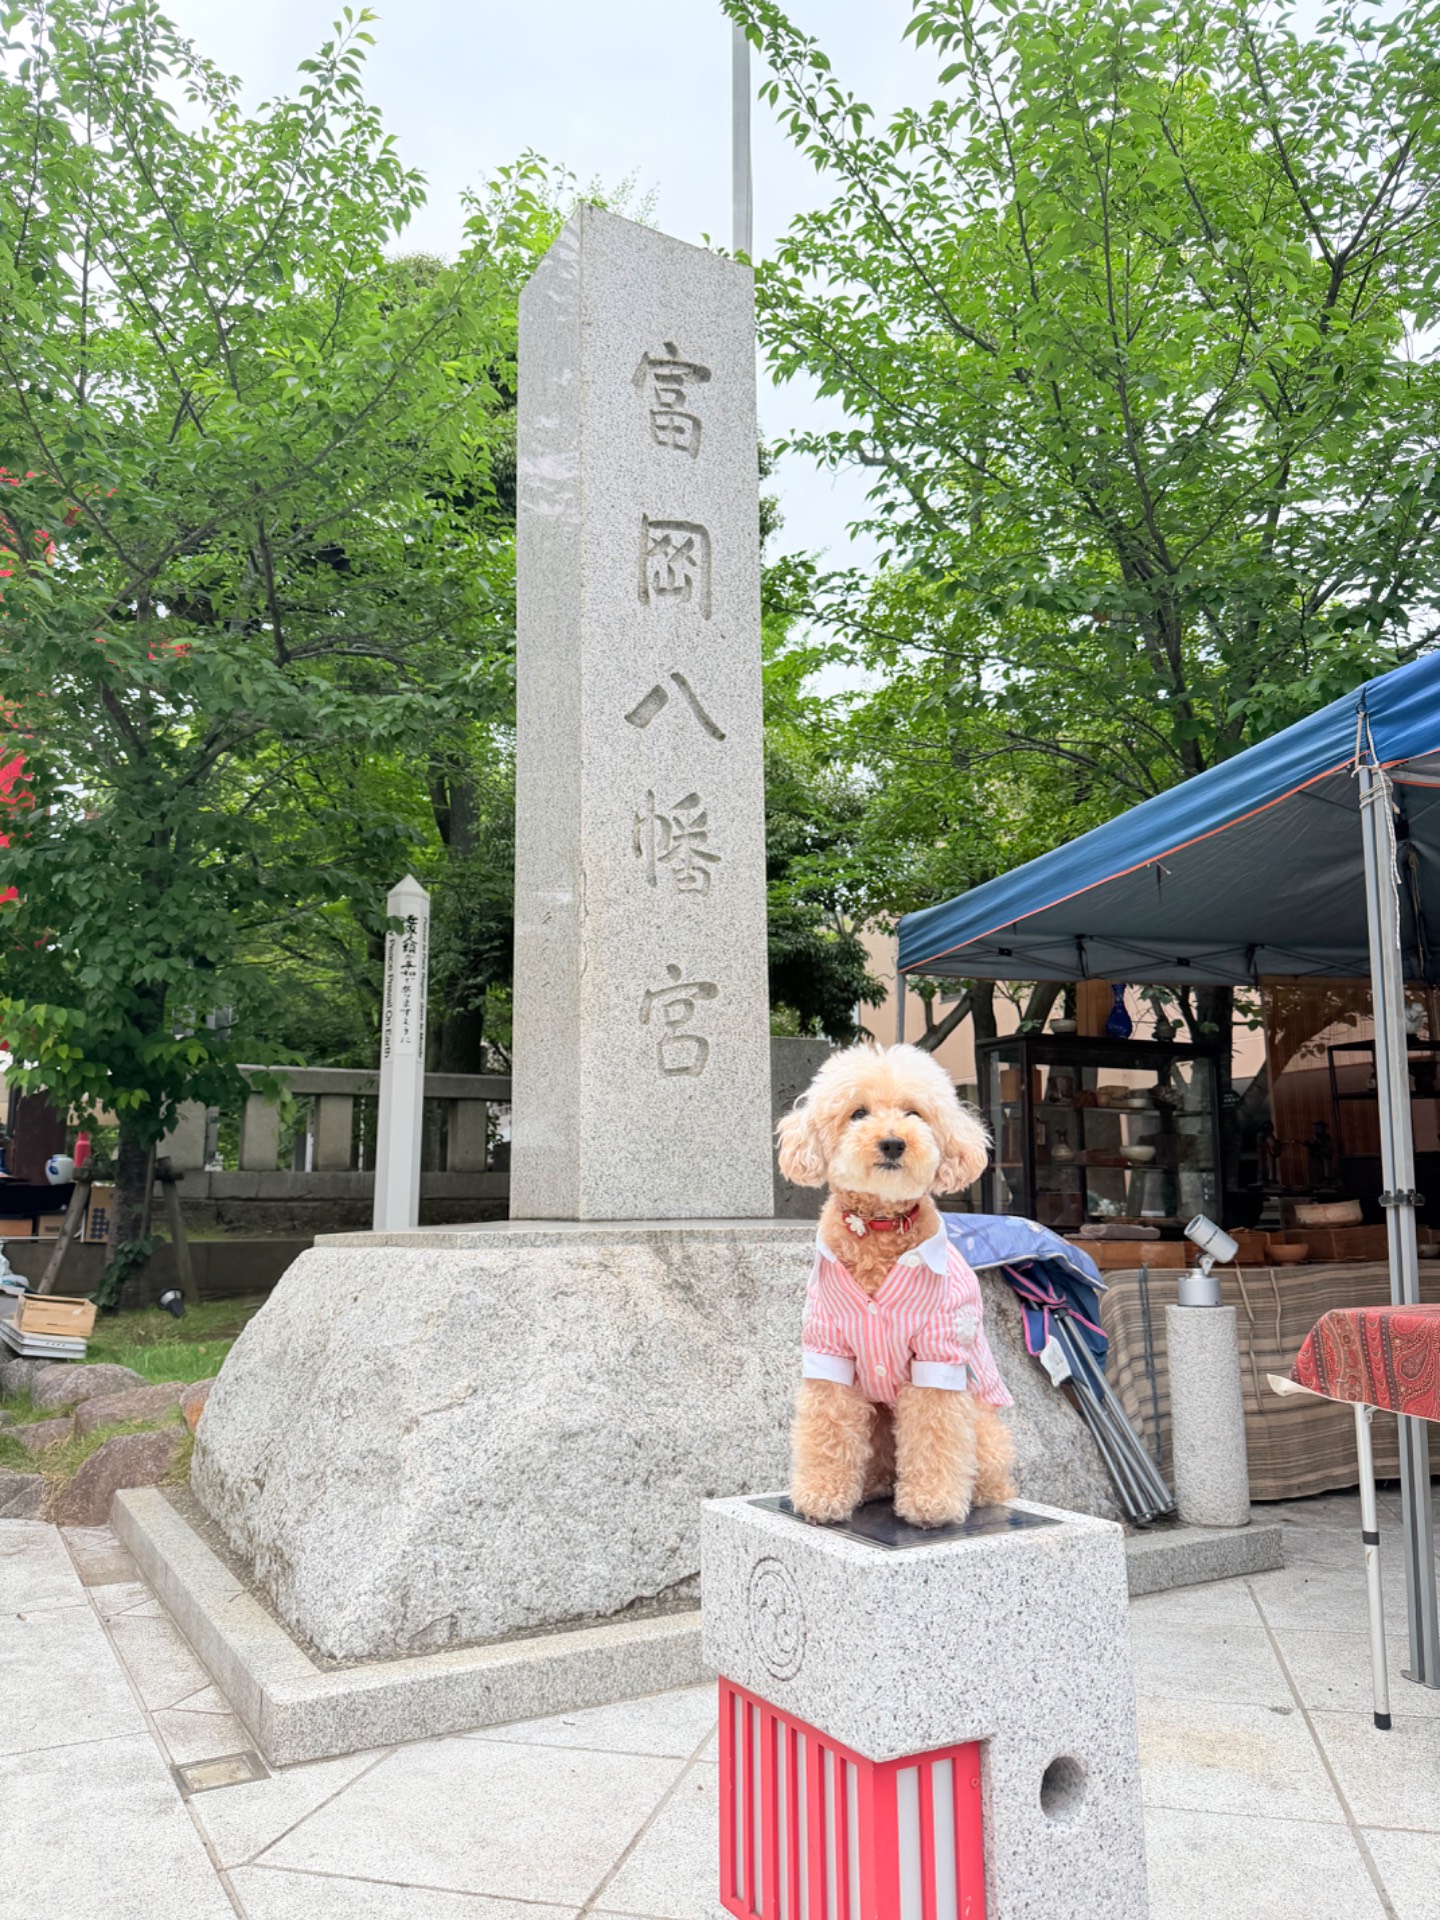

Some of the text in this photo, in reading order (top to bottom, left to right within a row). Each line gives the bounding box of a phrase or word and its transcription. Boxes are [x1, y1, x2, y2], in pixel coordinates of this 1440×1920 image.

[623, 341, 726, 1077] 富岡八幡宮
[387, 939, 396, 972] Peace
[386, 974, 395, 1009] Prevail
[385, 1010, 394, 1026] On
[384, 1028, 392, 1059] Earth
